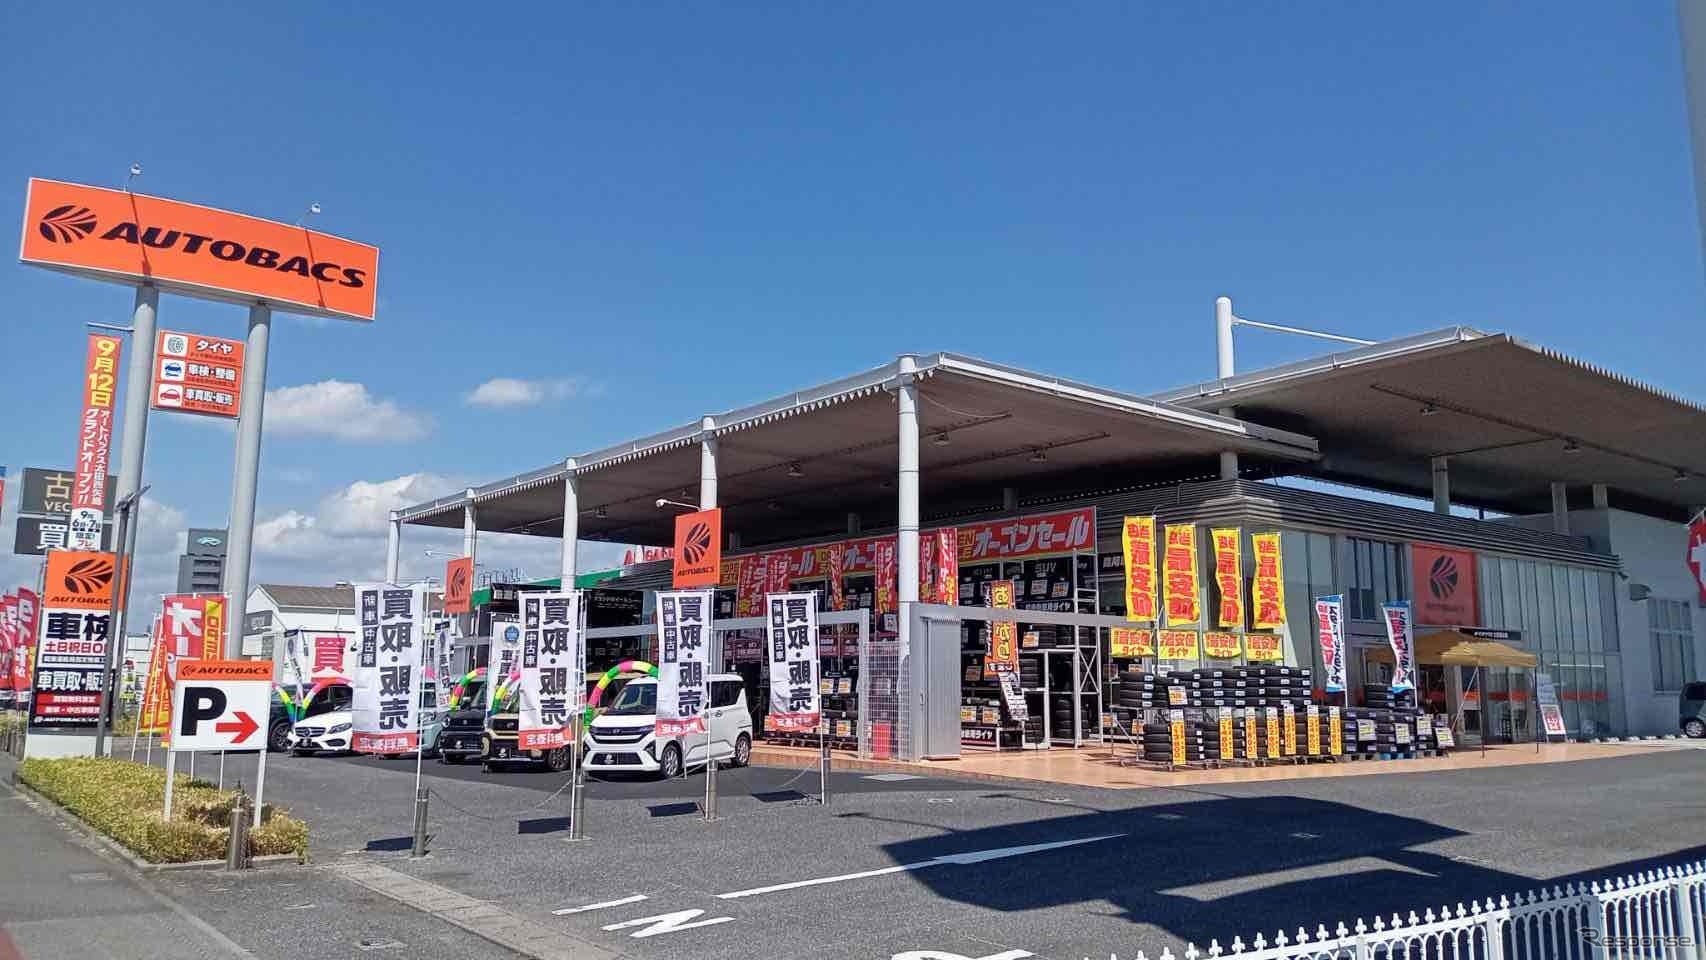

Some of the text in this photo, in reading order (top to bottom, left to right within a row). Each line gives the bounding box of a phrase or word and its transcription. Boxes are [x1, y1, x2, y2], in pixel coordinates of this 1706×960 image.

[100, 222, 367, 288] AUTOBACS
[196, 339, 233, 354] タイヤ
[88, 339, 116, 407] 9月12日
[44, 473, 74, 499] 古
[972, 514, 1090, 558] オープンセール
[50, 595, 112, 605] AUTOBAC
[44, 641, 106, 655] 土日祝日O
[311, 637, 347, 673] 買
[197, 665, 269, 675] AUTOBACS
[181, 686, 227, 736] P
